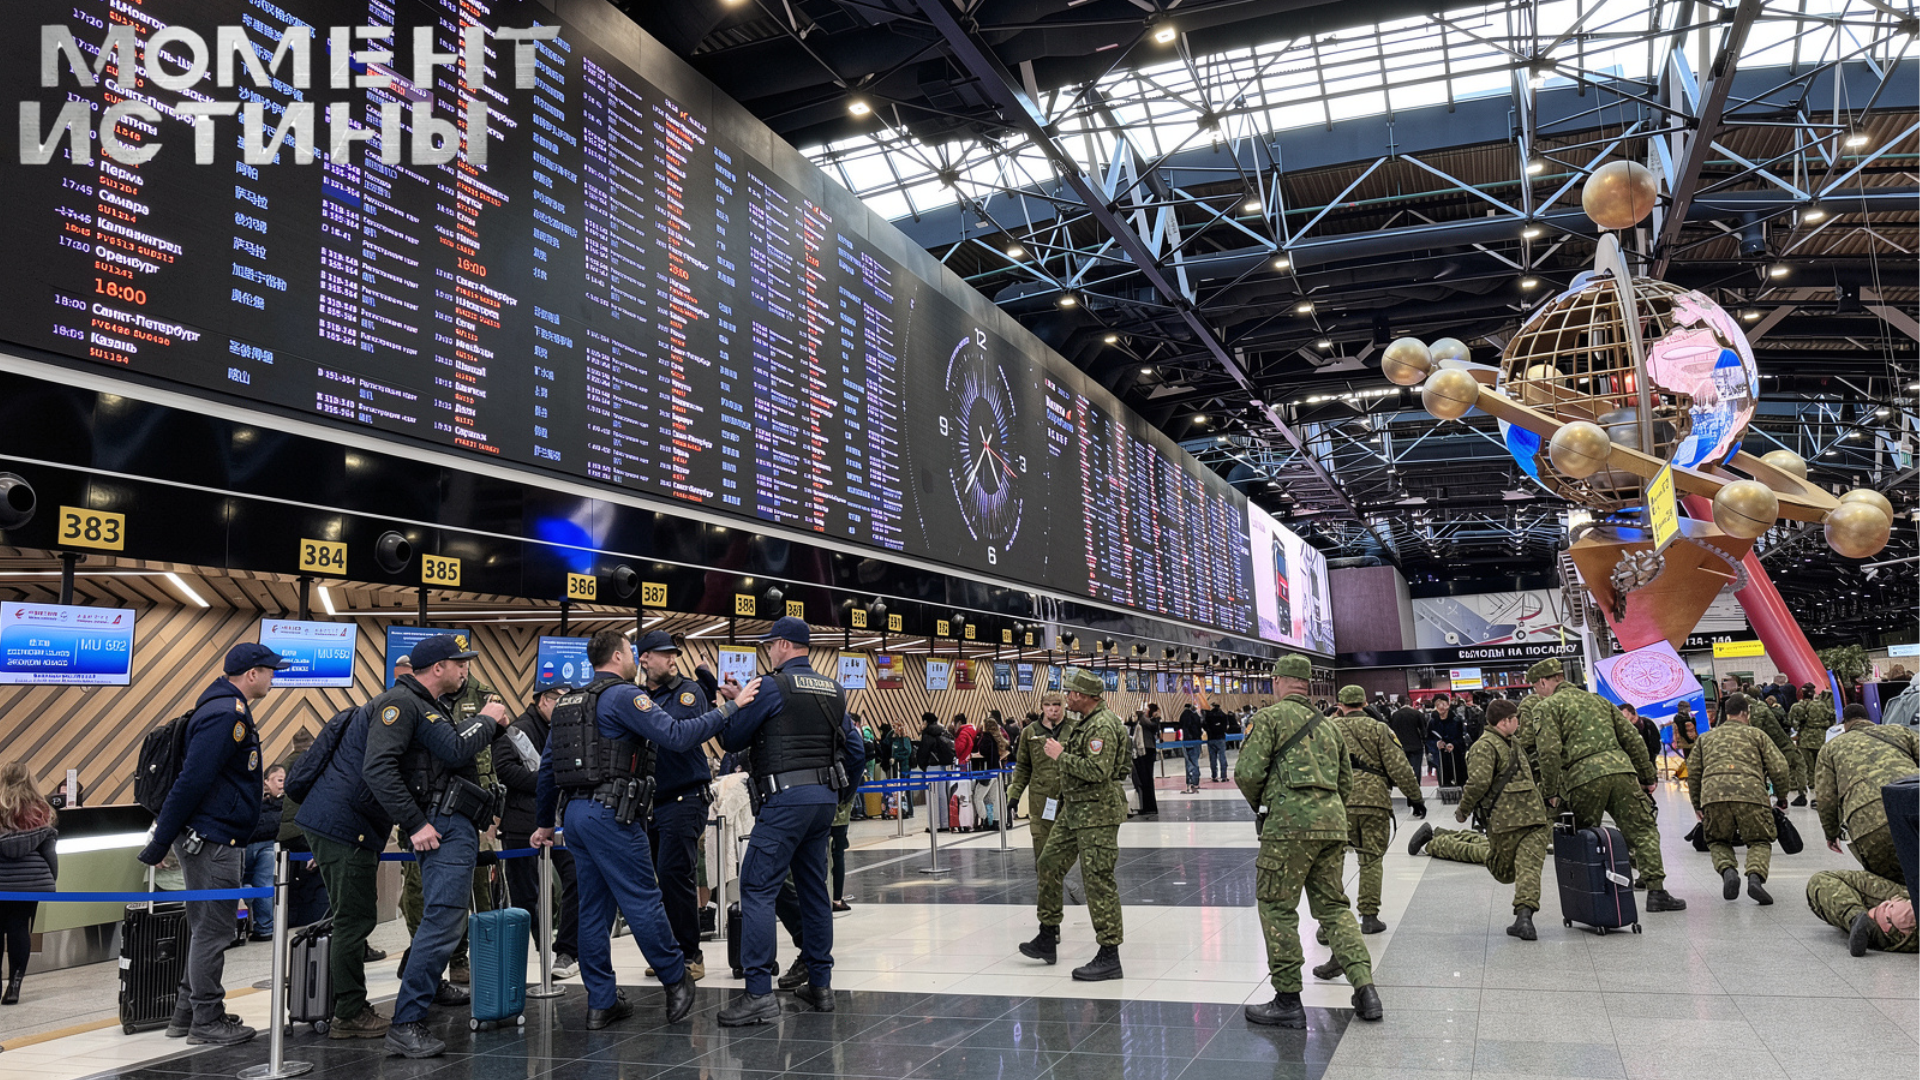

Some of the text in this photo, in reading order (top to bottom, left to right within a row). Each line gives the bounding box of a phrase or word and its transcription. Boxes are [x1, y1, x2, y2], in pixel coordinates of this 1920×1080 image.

[73, 8, 104, 29] 17:20
[62, 177, 149, 216] 17:45 Самара
[95, 245, 161, 275] Оренбург
[54, 293, 87, 311] 18:00
[94, 277, 147, 306] 18:00
[90, 331, 138, 354] Казань
[939, 416, 949, 437] 9
[1018, 455, 1028, 473] 3
[64, 513, 120, 544] 383
[304, 544, 345, 569] 384
[987, 546, 997, 565] 6
[425, 559, 458, 581] 385
[570, 577, 595, 595] 386
[644, 587, 665, 603] 387
[81, 638, 102, 651] MU
[1508, 645, 1523, 657] НА
